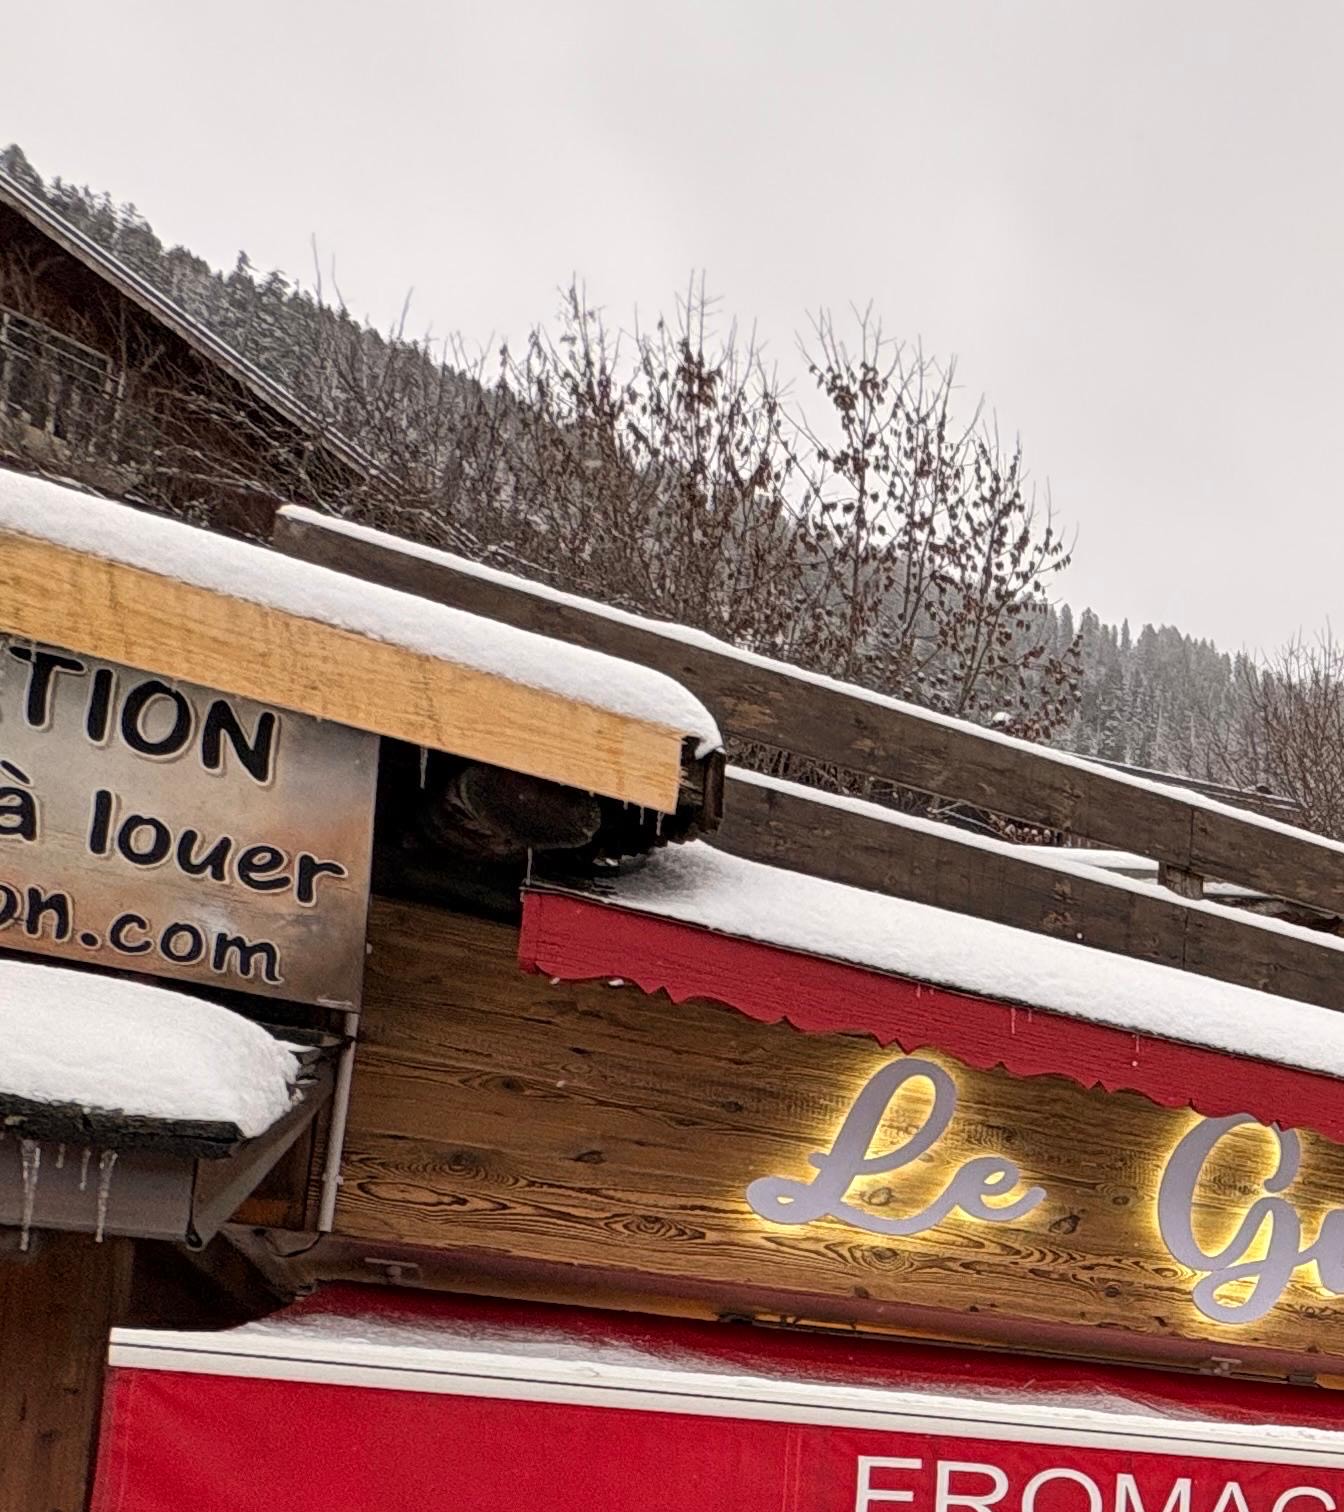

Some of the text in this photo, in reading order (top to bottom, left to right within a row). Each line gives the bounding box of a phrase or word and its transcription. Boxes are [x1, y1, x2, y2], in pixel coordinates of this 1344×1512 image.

[6, 646, 277, 783] TION
[90, 789, 347, 904] louer
[746, 1057, 1047, 1237] Le
